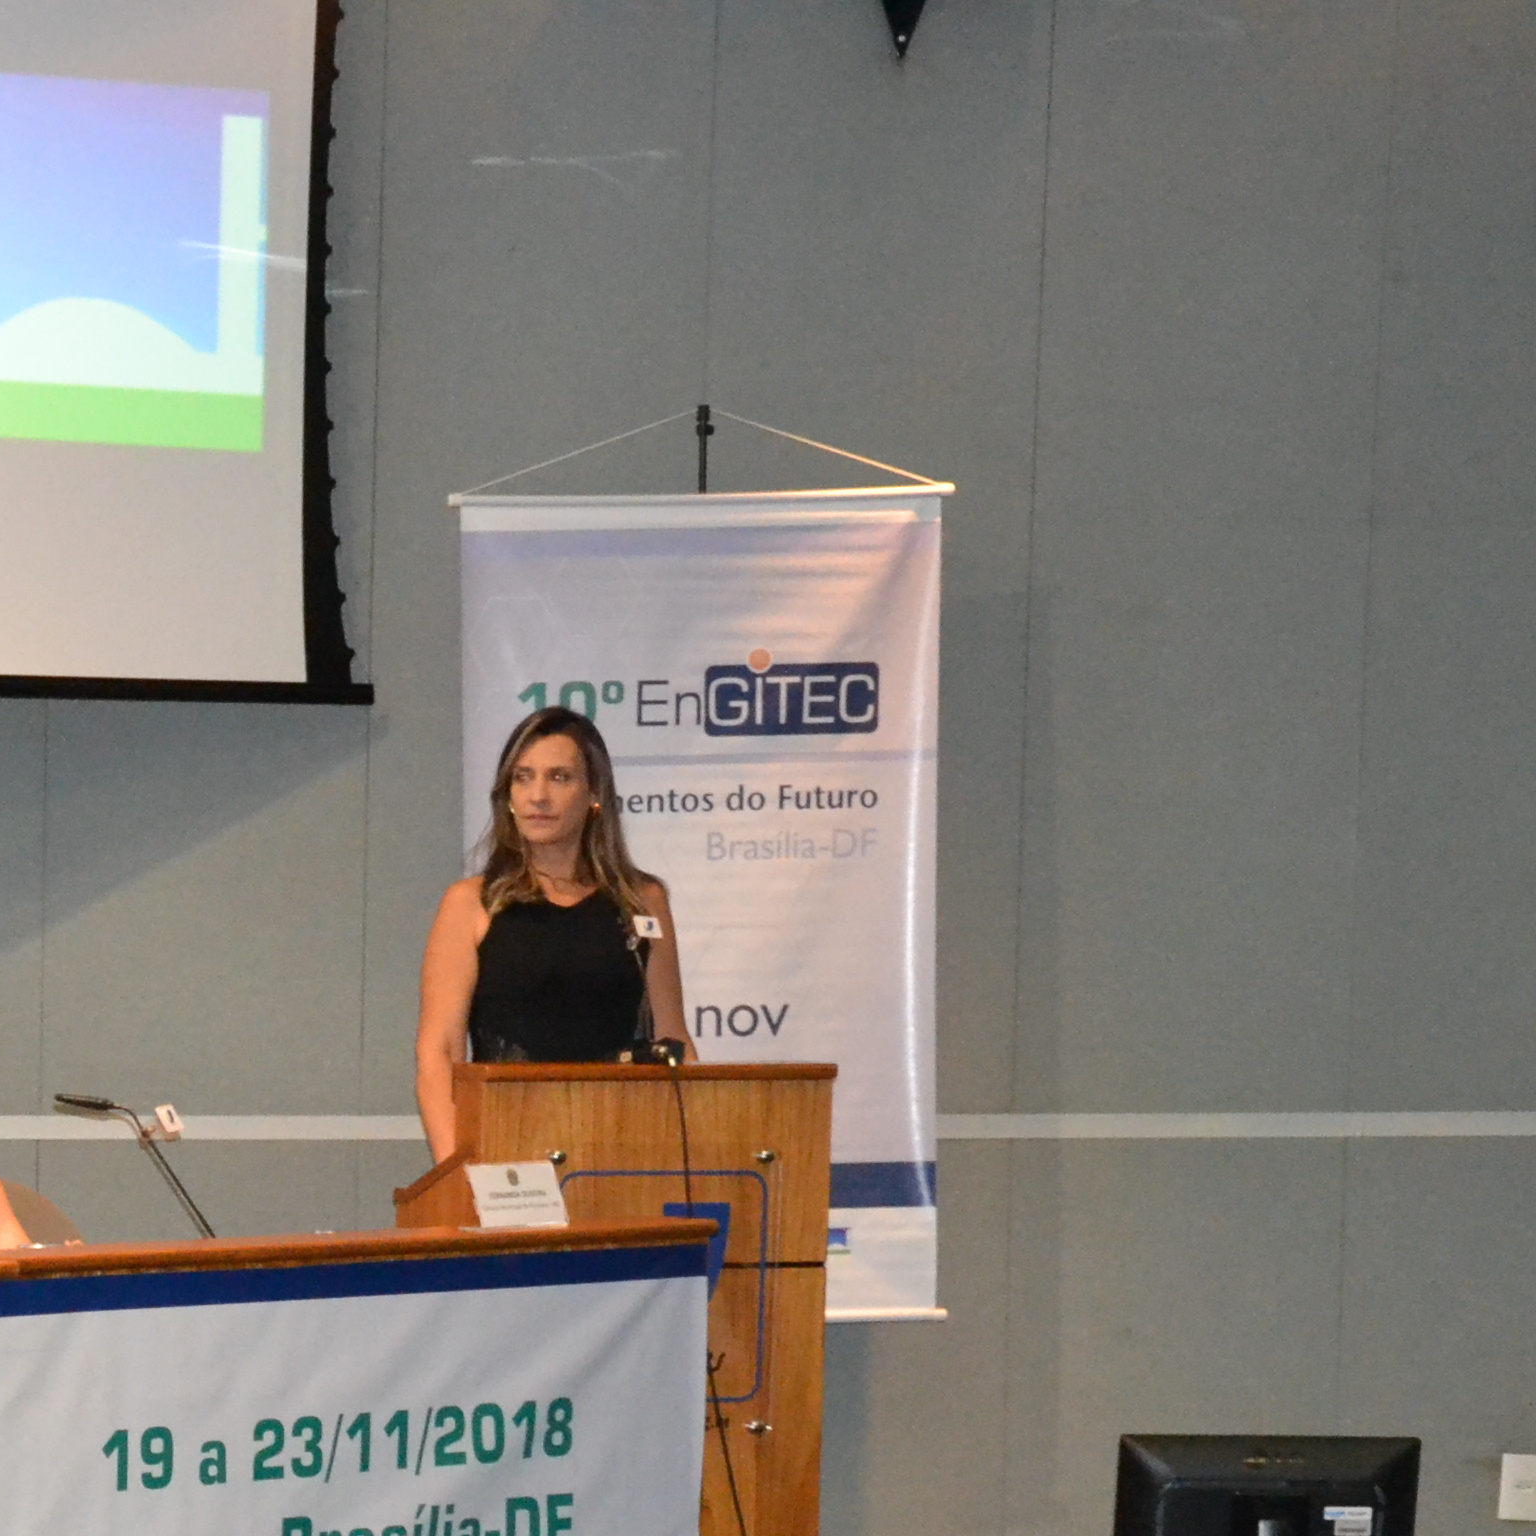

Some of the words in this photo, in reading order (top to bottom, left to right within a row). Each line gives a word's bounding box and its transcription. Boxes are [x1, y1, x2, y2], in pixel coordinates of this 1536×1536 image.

[725, 785, 766, 812] do
[778, 783, 879, 812] Futuro
[705, 827, 879, 862] Brasília-DF
[696, 1003, 790, 1038] nov
[102, 1425, 175, 1493] 19
[199, 1439, 228, 1487] a
[252, 1397, 575, 1484] 23/11/2018
